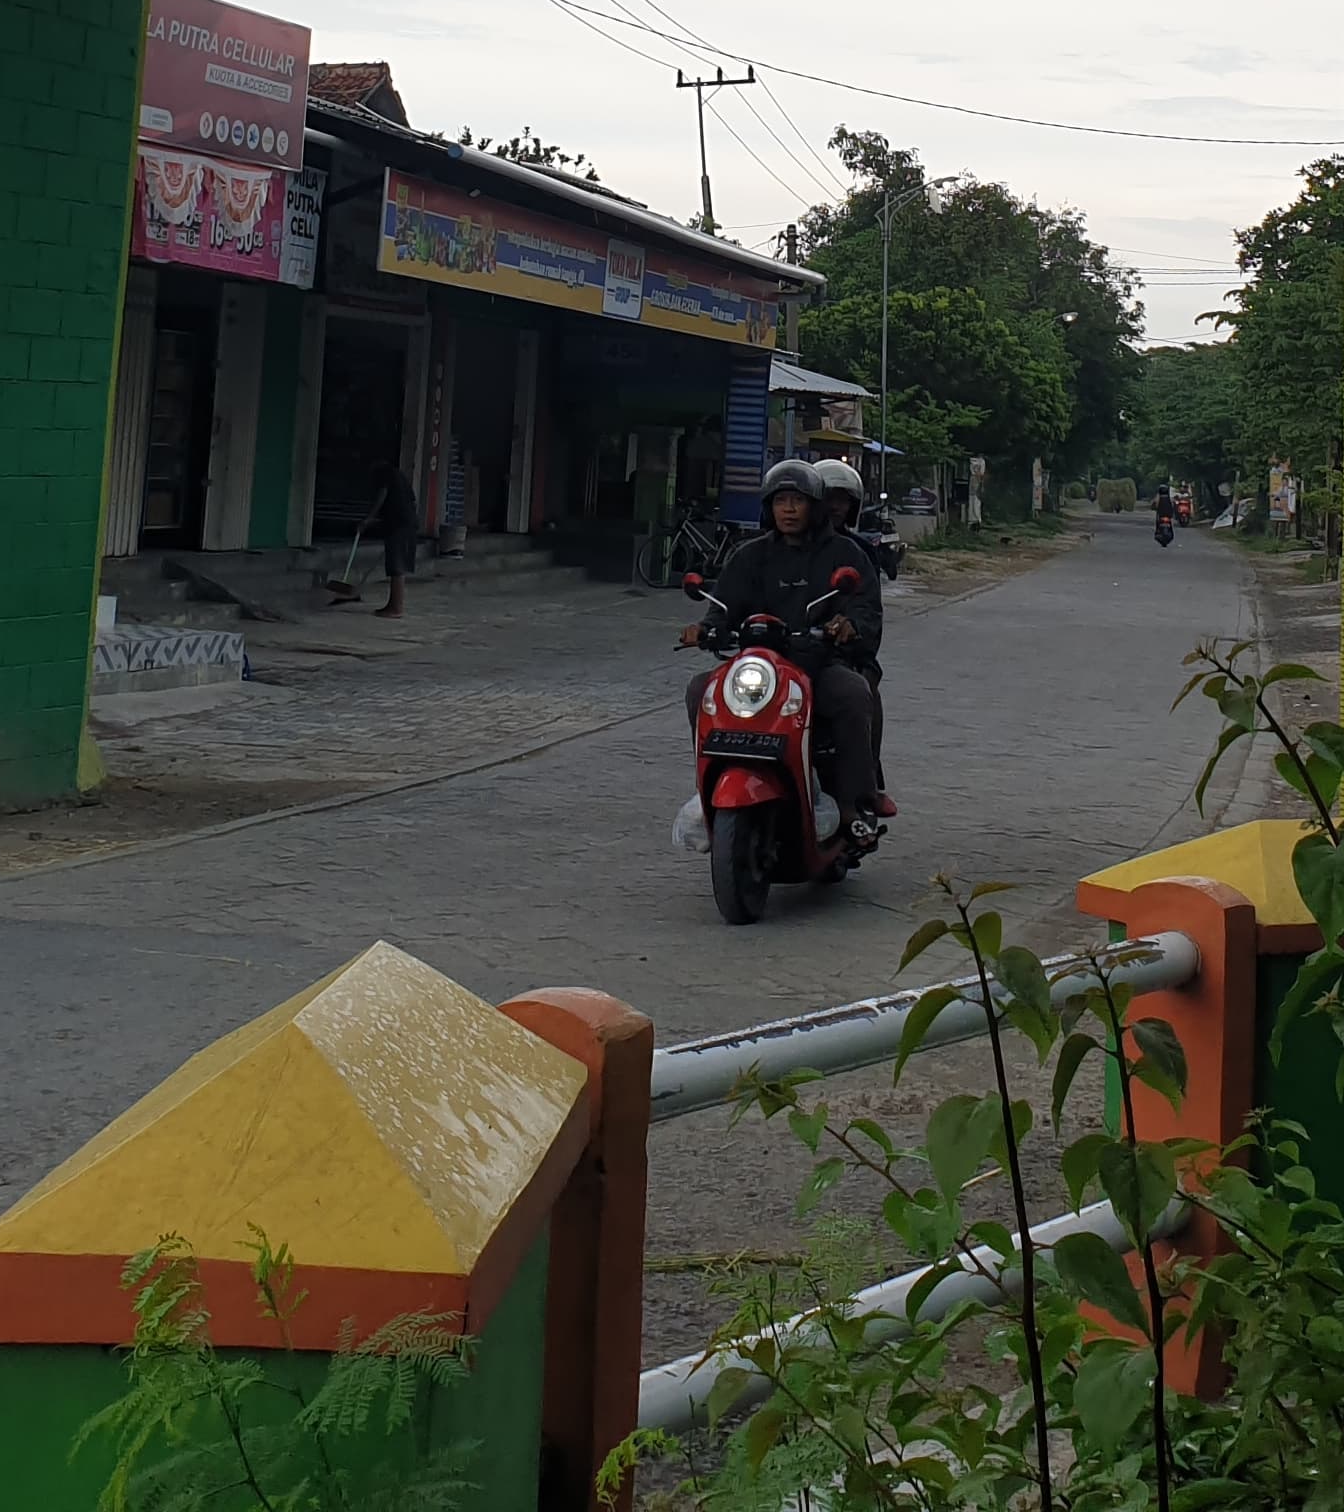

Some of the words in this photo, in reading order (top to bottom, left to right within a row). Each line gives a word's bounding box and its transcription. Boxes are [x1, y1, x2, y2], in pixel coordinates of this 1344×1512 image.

[168, 20, 219, 55] PUTRA
[223, 36, 295, 77] CELLULAR
[287, 190, 321, 216] PUTRA
[291, 216, 314, 239] CELL
